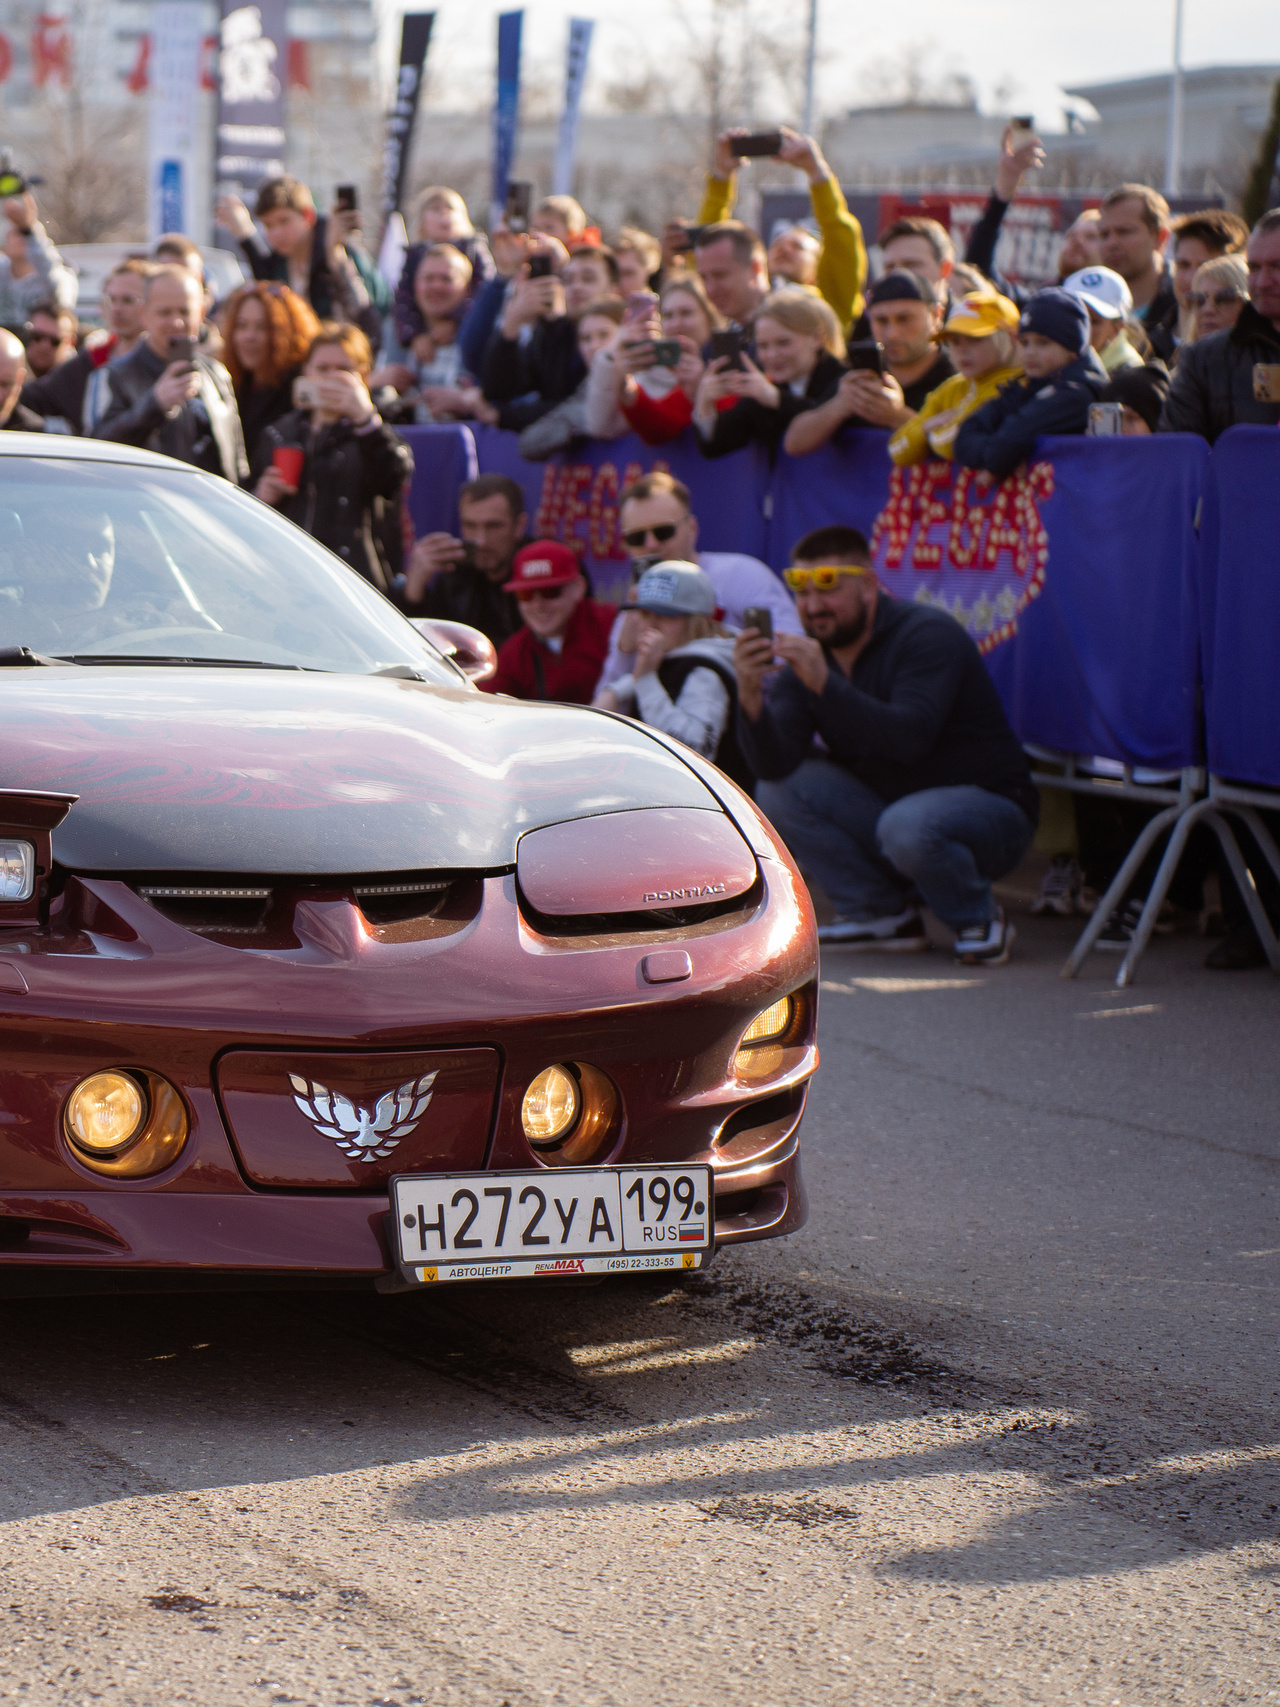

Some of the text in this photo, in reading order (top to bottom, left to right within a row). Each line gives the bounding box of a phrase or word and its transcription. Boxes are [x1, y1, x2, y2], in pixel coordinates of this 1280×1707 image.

[643, 882, 726, 902] PONTIAC
[625, 1175, 696, 1222] 199
[643, 1225, 678, 1242] RUS
[449, 1265, 512, 1278] АВТОЦЕНТР
[606, 1257, 675, 1270] (495) 22-333-55
